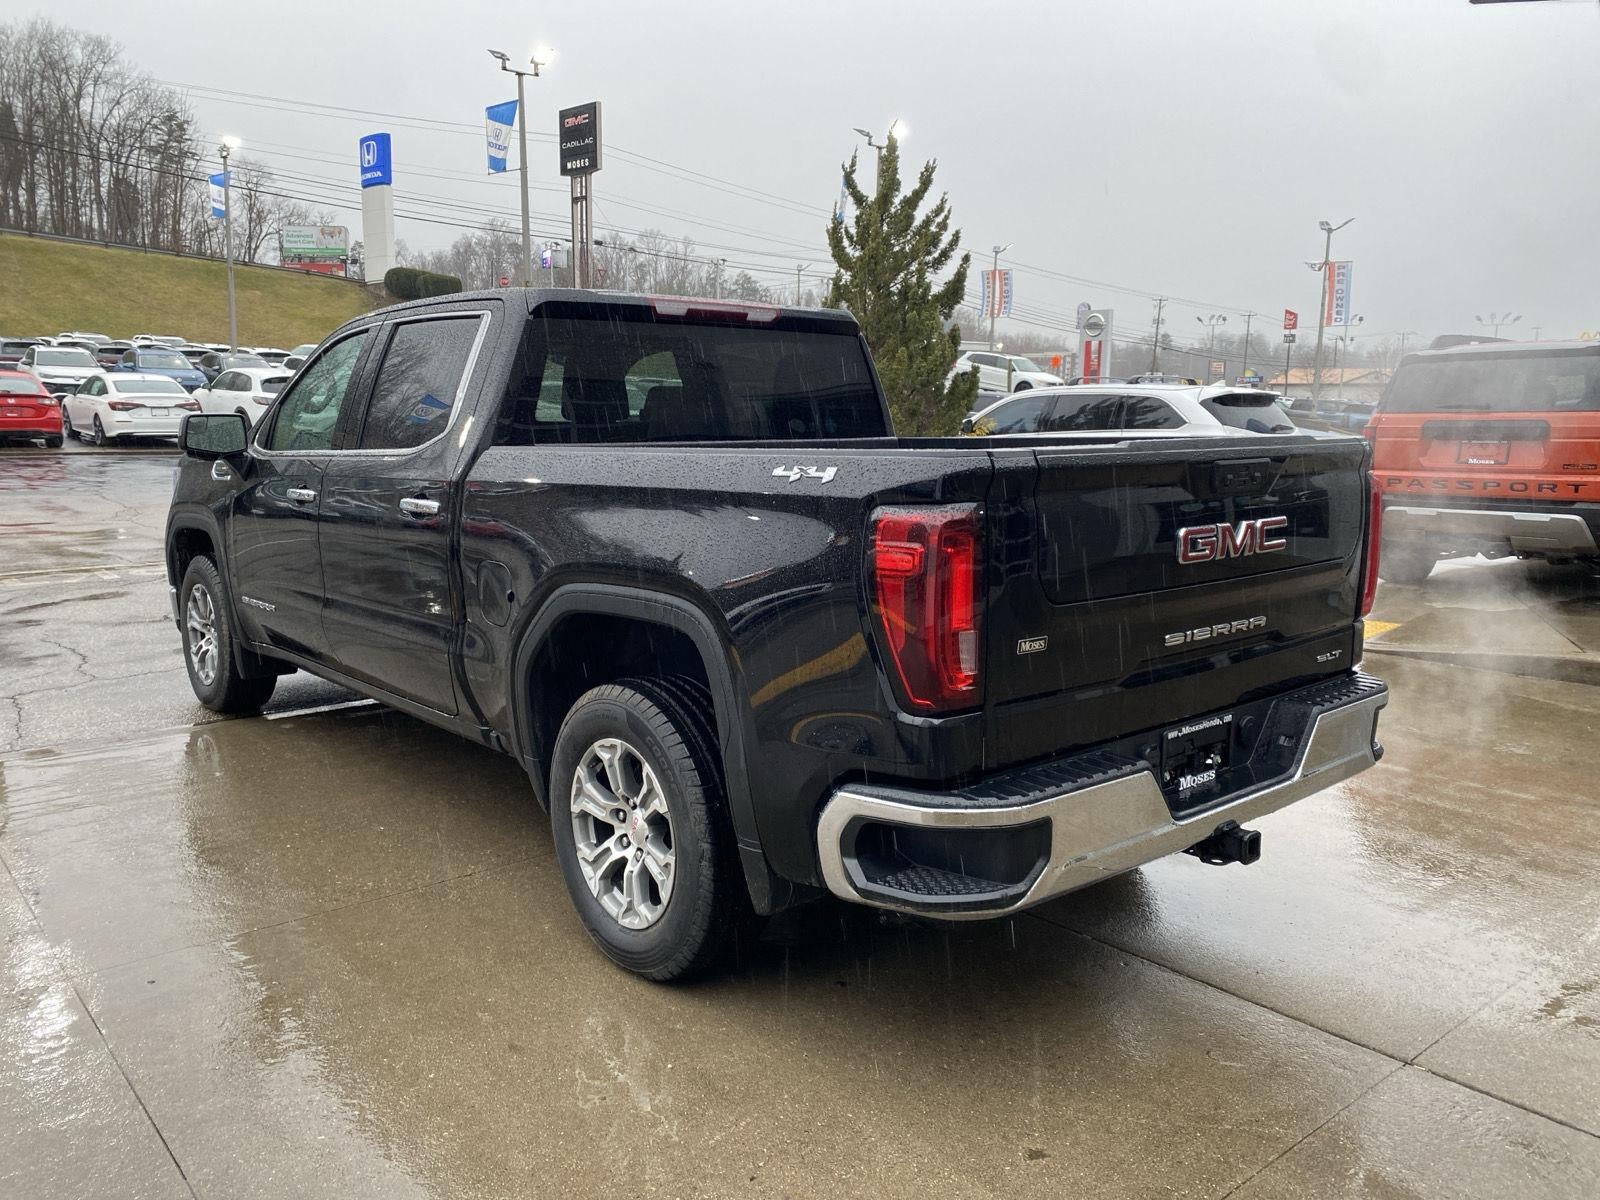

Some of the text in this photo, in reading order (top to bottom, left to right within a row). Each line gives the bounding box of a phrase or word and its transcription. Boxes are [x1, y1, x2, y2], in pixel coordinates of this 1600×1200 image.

[564, 113, 589, 128] GMC
[561, 137, 594, 149] CADILLAC
[566, 158, 589, 169] MOSES
[1334, 264, 1346, 323] PRE OWNED
[1386, 478, 1588, 494] PASSPORT
[1177, 515, 1288, 565] GMC
[1164, 615, 1267, 647] SIERRA
[1316, 649, 1343, 664] SLT
